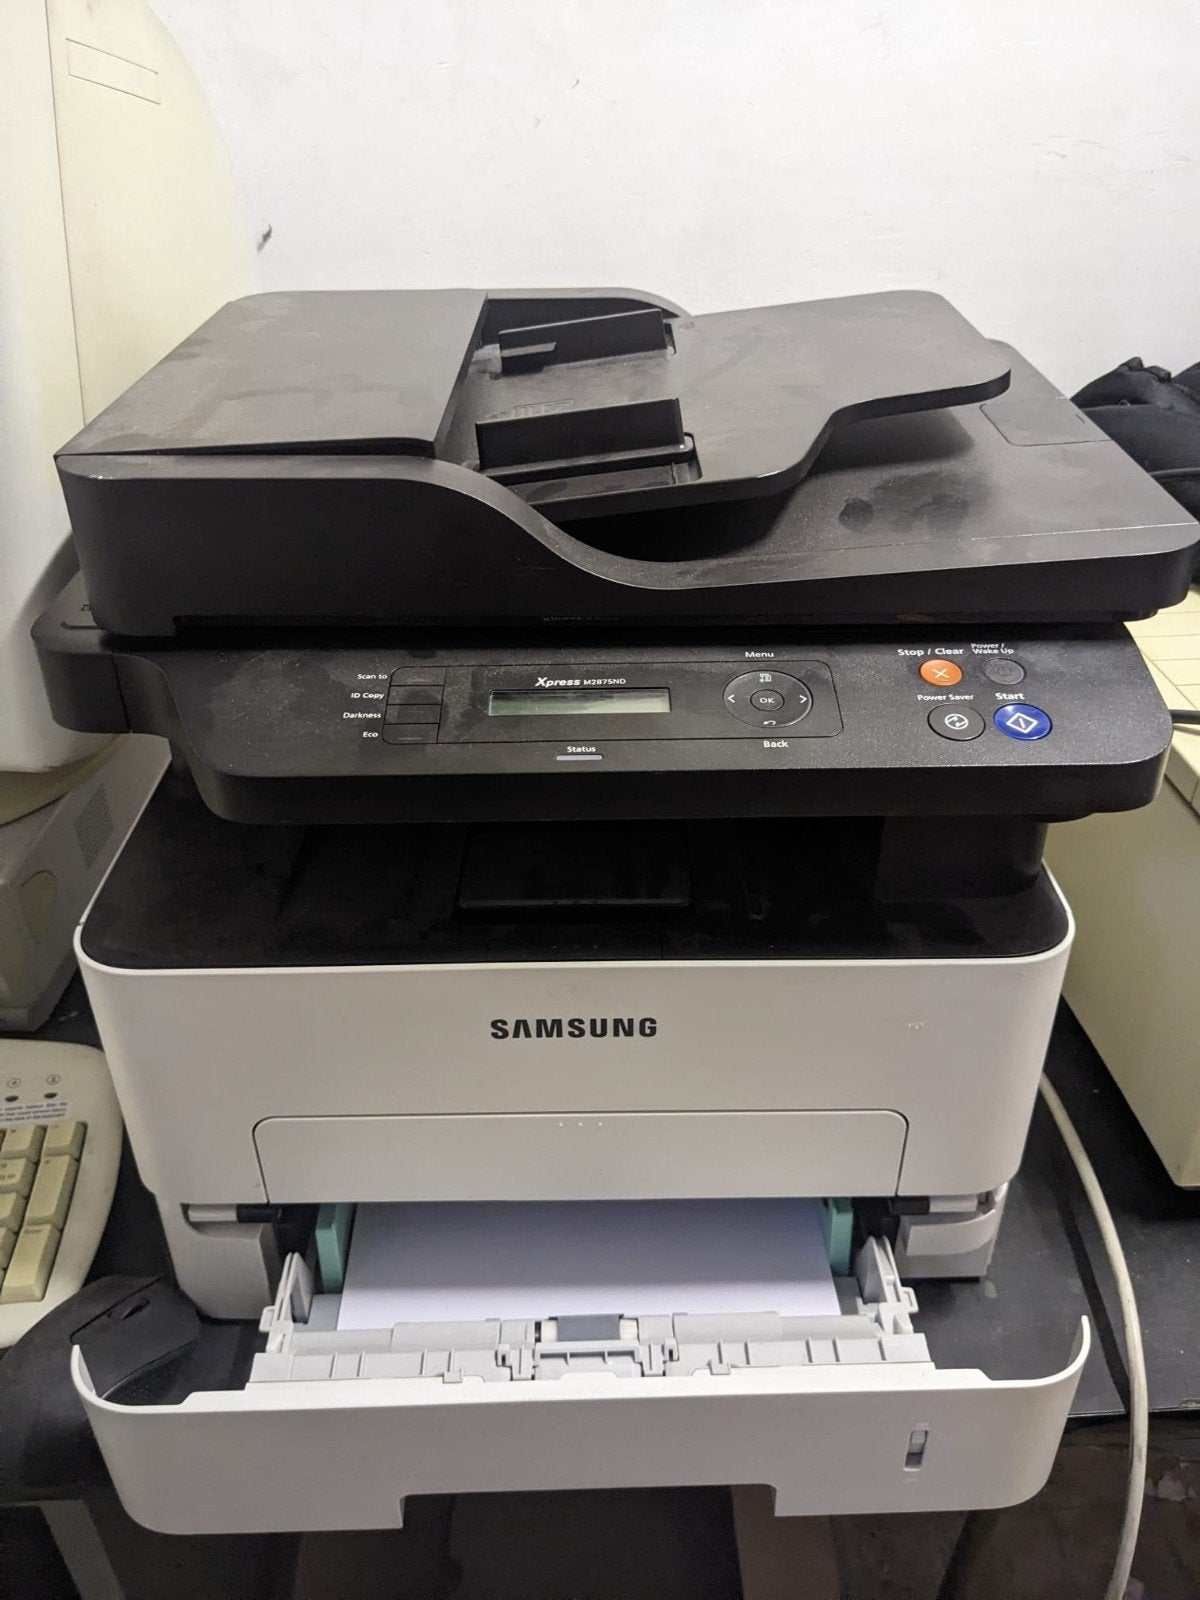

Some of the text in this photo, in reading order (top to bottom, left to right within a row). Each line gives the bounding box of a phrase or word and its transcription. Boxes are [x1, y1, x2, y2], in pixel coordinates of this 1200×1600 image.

[535, 677, 580, 687] Xpress
[362, 692, 384, 700] Copy
[343, 711, 382, 719] Darkness
[363, 730, 379, 738] Eco
[763, 740, 789, 748] Back
[490, 1017, 658, 1040] SAMSUNG
